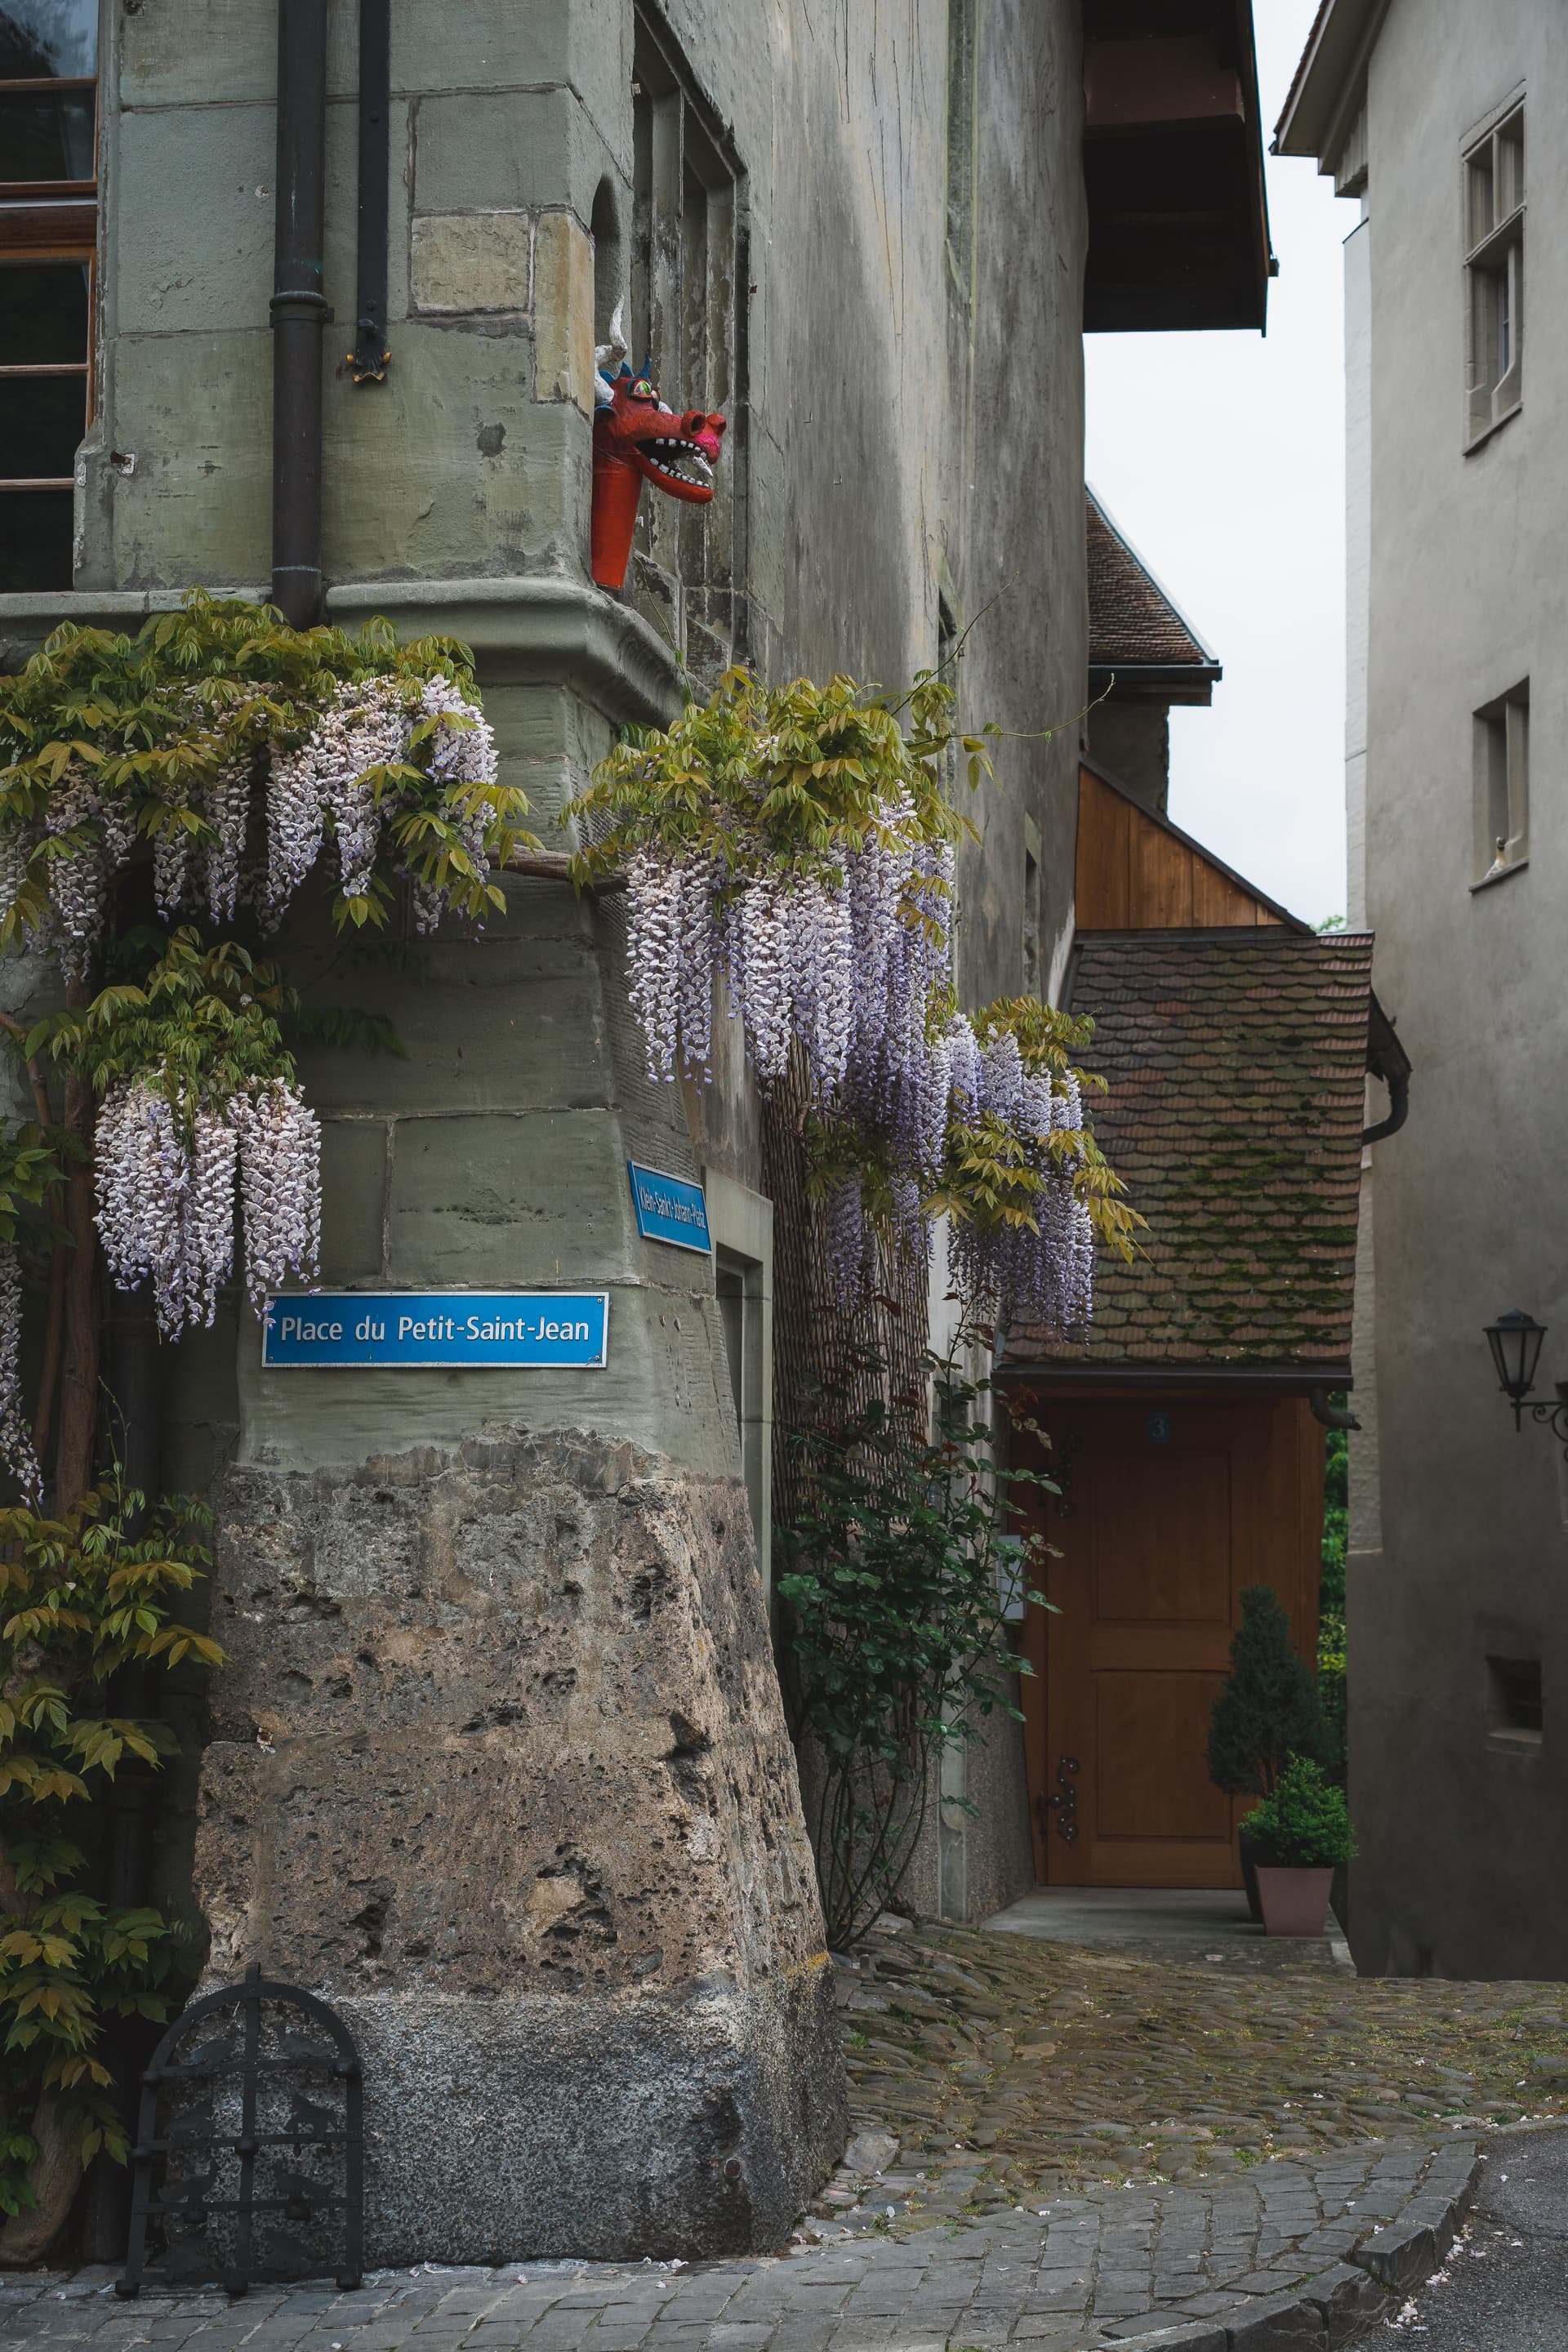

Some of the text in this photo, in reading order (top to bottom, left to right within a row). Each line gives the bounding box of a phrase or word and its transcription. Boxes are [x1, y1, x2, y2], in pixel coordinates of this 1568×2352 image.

[281, 1316, 590, 1341] Place du Petit-Saint-Jean
[1152, 1417, 1165, 1437] 3
